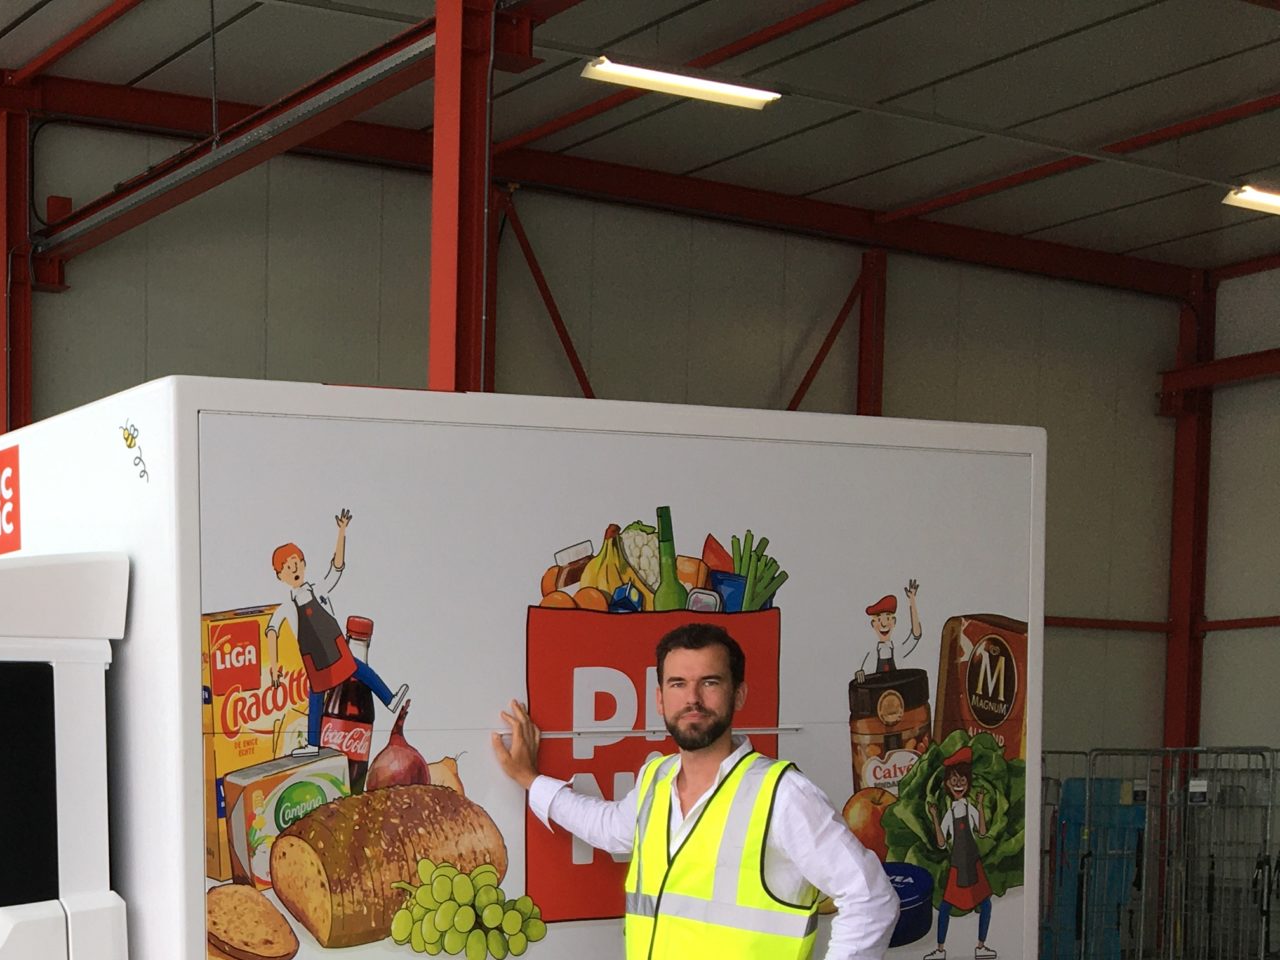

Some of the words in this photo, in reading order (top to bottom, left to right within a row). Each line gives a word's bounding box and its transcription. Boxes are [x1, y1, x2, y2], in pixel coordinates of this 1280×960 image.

[573, 666, 670, 759] PI
[971, 694, 1008, 716] MAGNUM
[967, 726, 1005, 747] ALND
